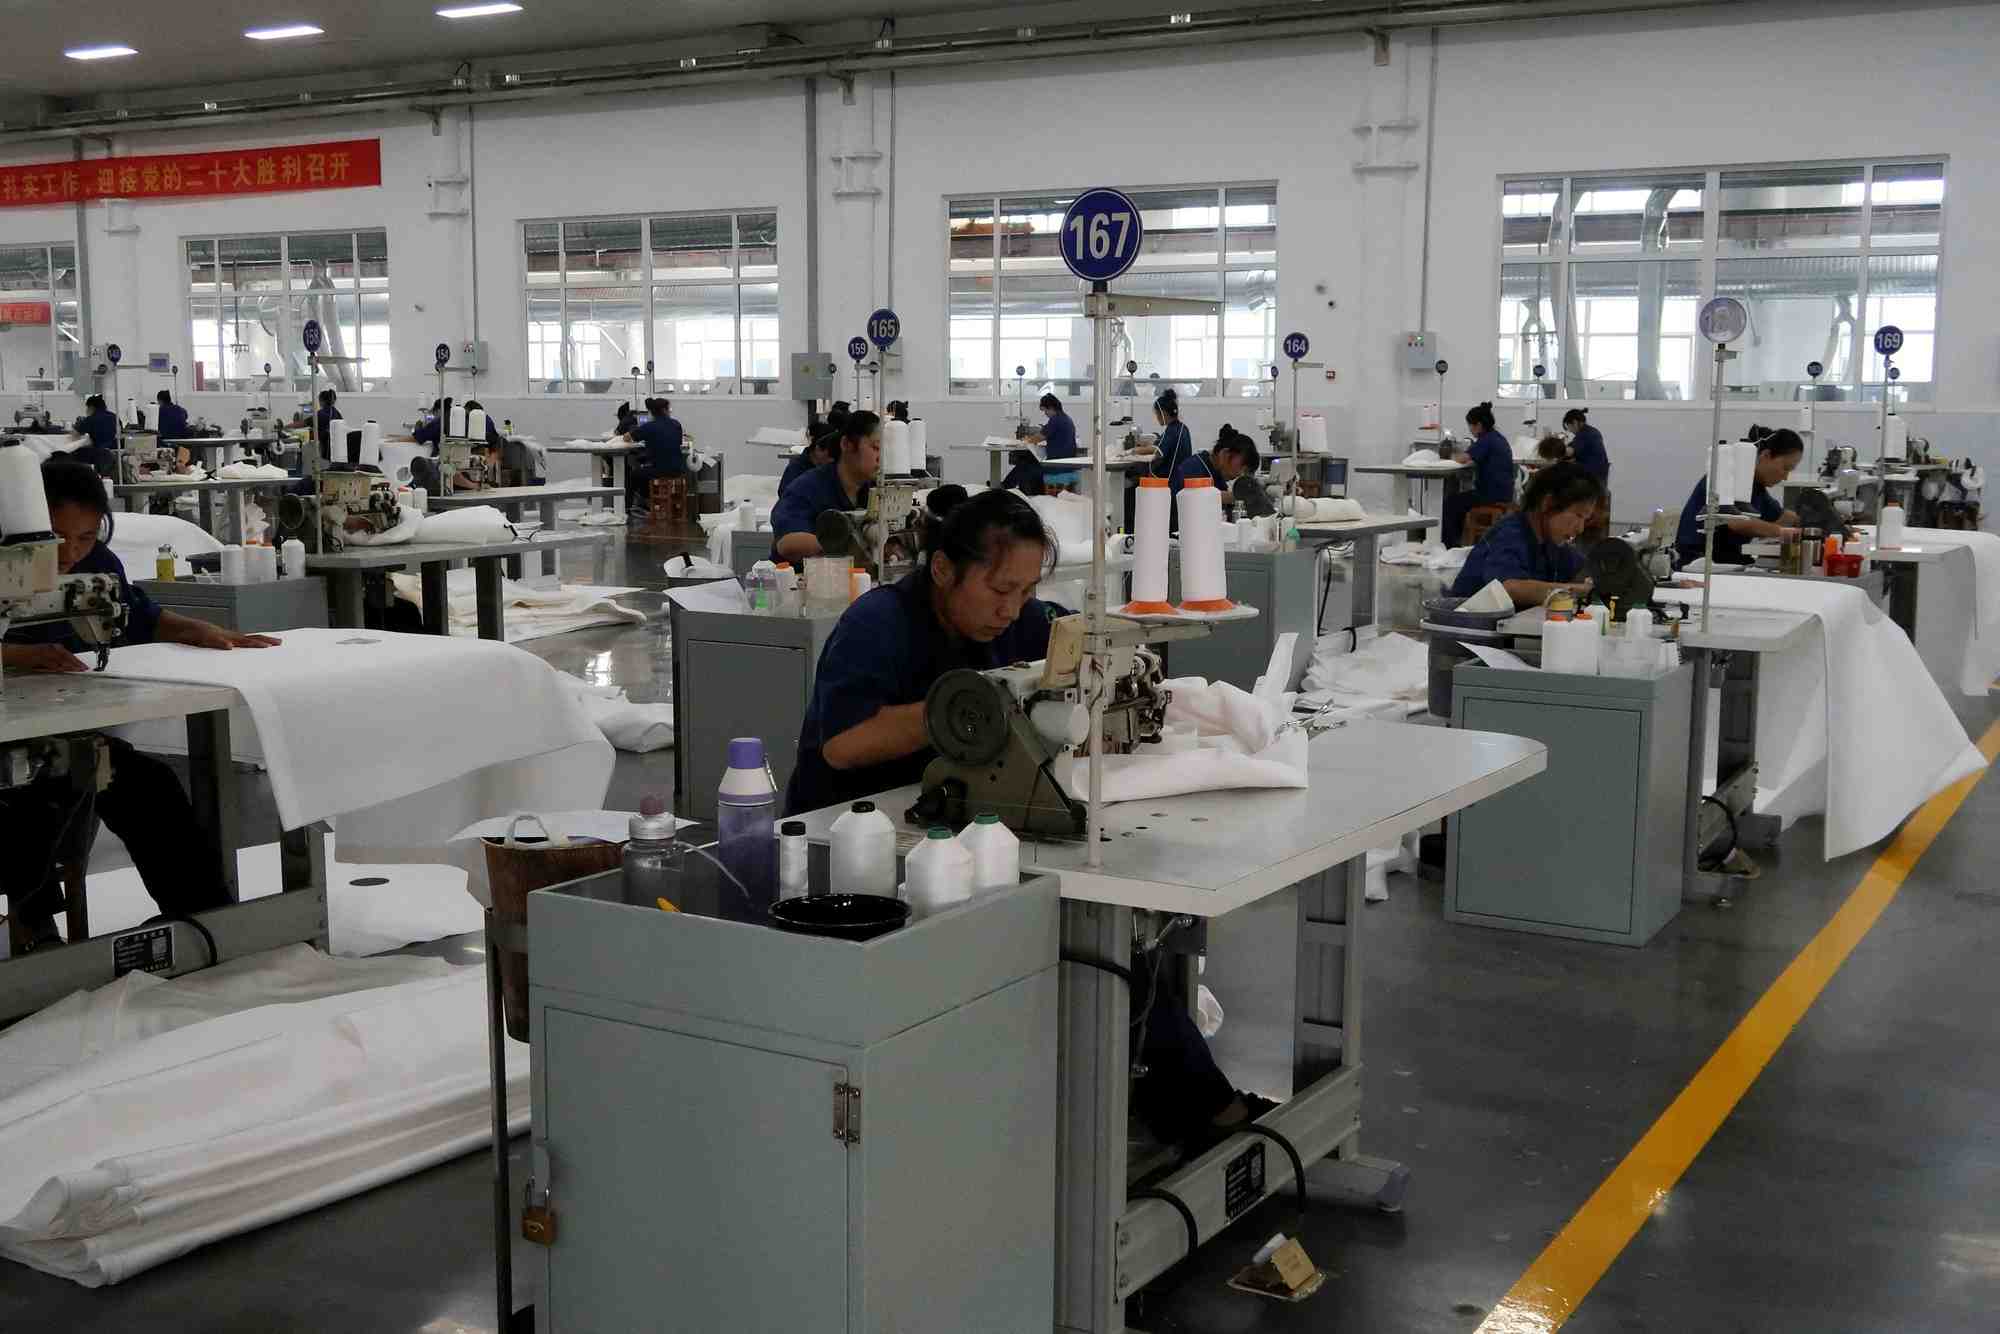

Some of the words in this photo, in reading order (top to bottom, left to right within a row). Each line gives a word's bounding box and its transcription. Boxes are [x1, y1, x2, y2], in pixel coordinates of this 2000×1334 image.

[1070, 212, 1130, 260] 167
[871, 319, 897, 338] 165
[850, 342, 866, 356] 159
[1286, 338, 1306, 353] 164
[1876, 333, 1900, 349] 169
